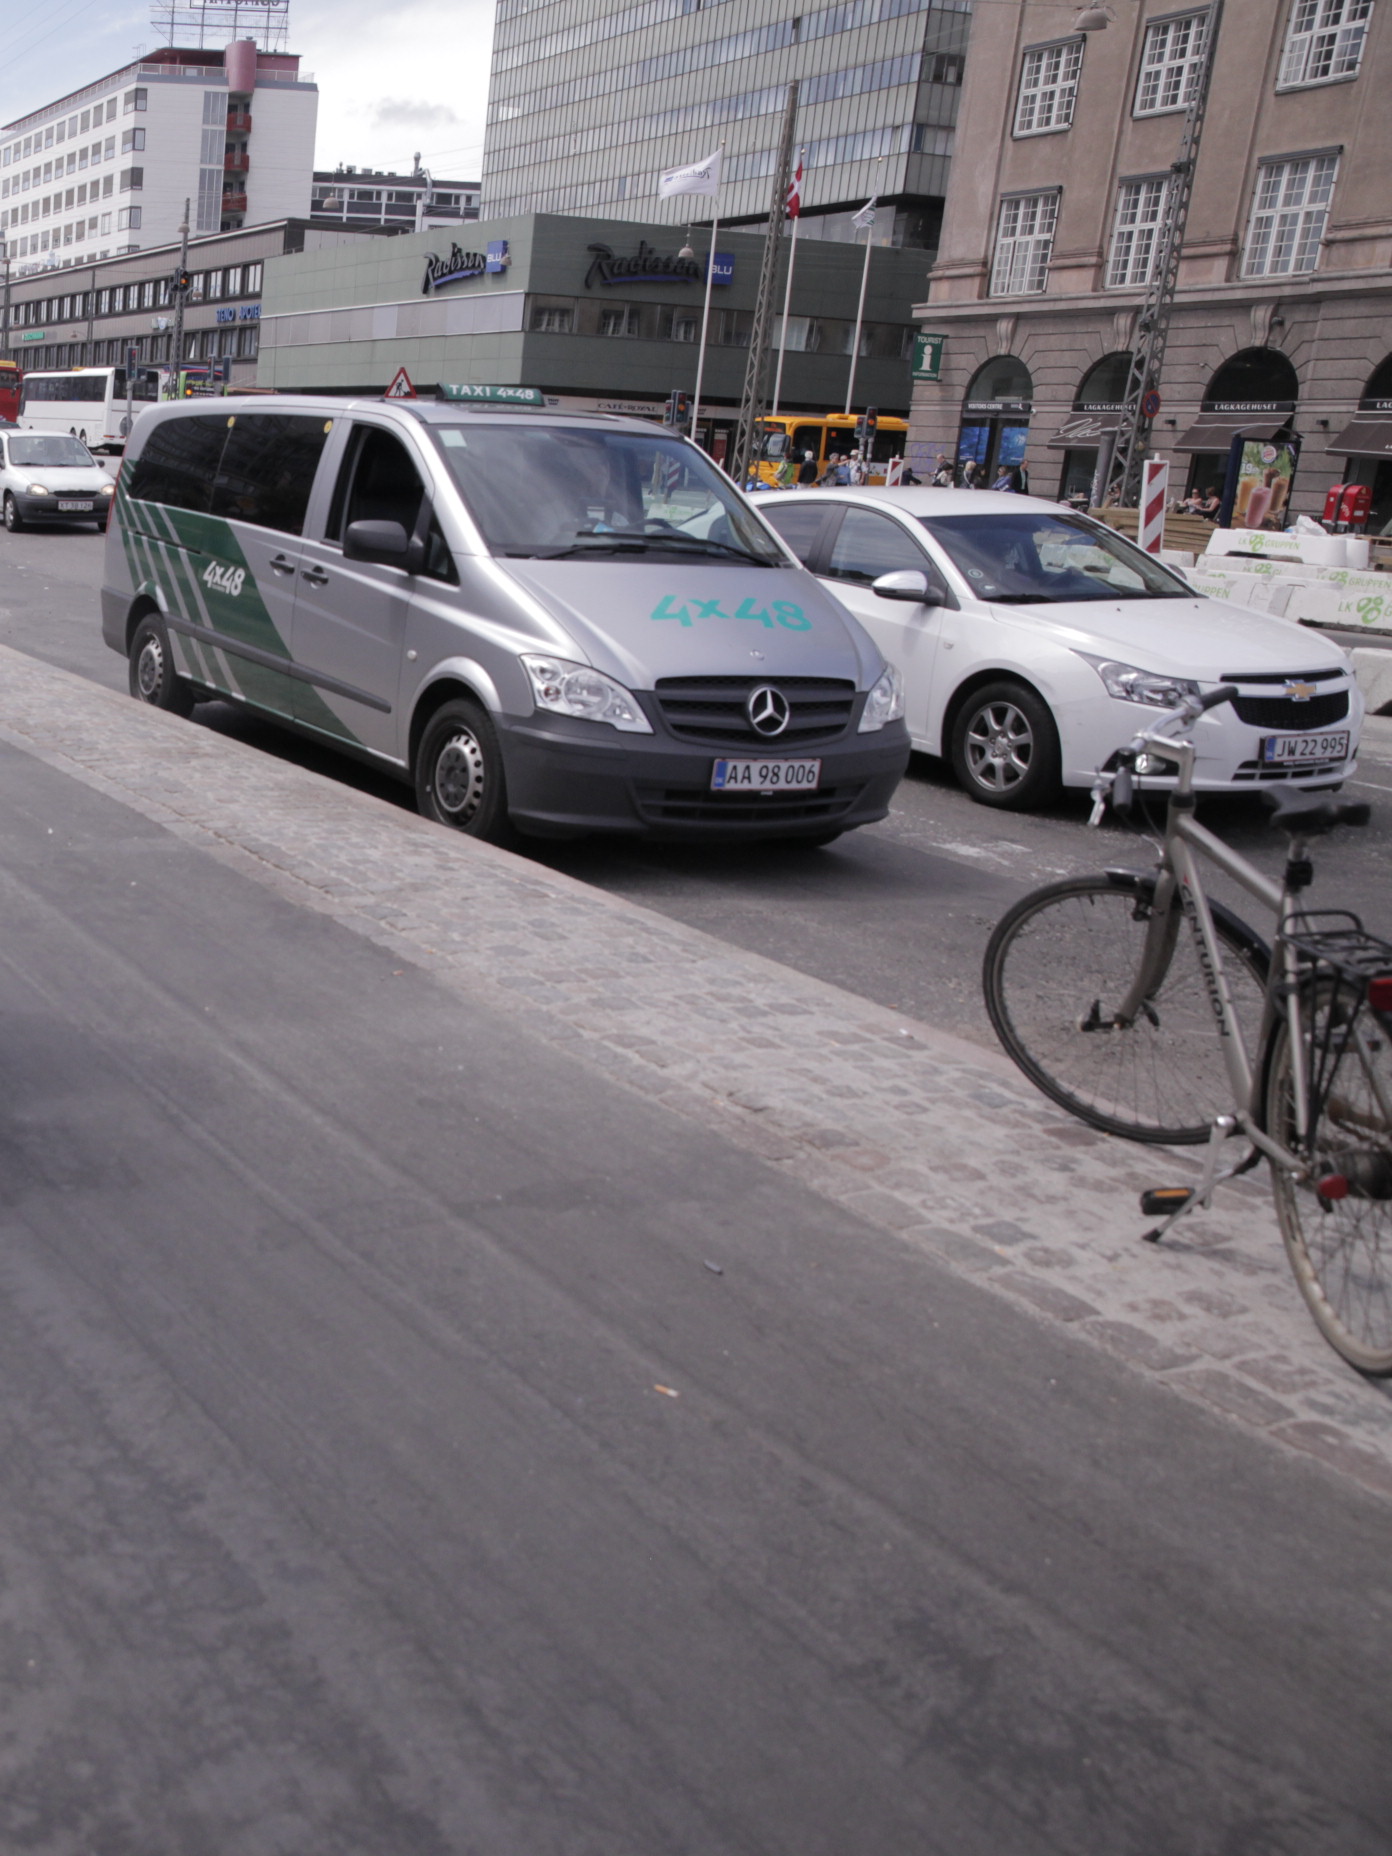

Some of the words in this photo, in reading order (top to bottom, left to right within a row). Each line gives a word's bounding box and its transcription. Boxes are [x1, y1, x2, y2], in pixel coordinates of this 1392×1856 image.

[421, 242, 486, 294] Radisson
[487, 253, 502, 262] BLU
[584, 240, 701, 289] Radisson
[710, 266, 733, 275] BLU
[917, 336, 943, 344] TOURIST
[449, 384, 491, 397] TAXI
[1214, 403, 1277, 411] LAGKAGEHUSET
[1337, 600, 1354, 613] LK
[1277, 740, 1298, 757] JW
[1299, 739, 1318, 756] 22
[1320, 737, 1345, 755] 995
[726, 764, 752, 784] AA
[758, 764, 781, 785] 98
[785, 764, 816, 784] 006
[1181, 885, 1231, 1037] CENTURION
